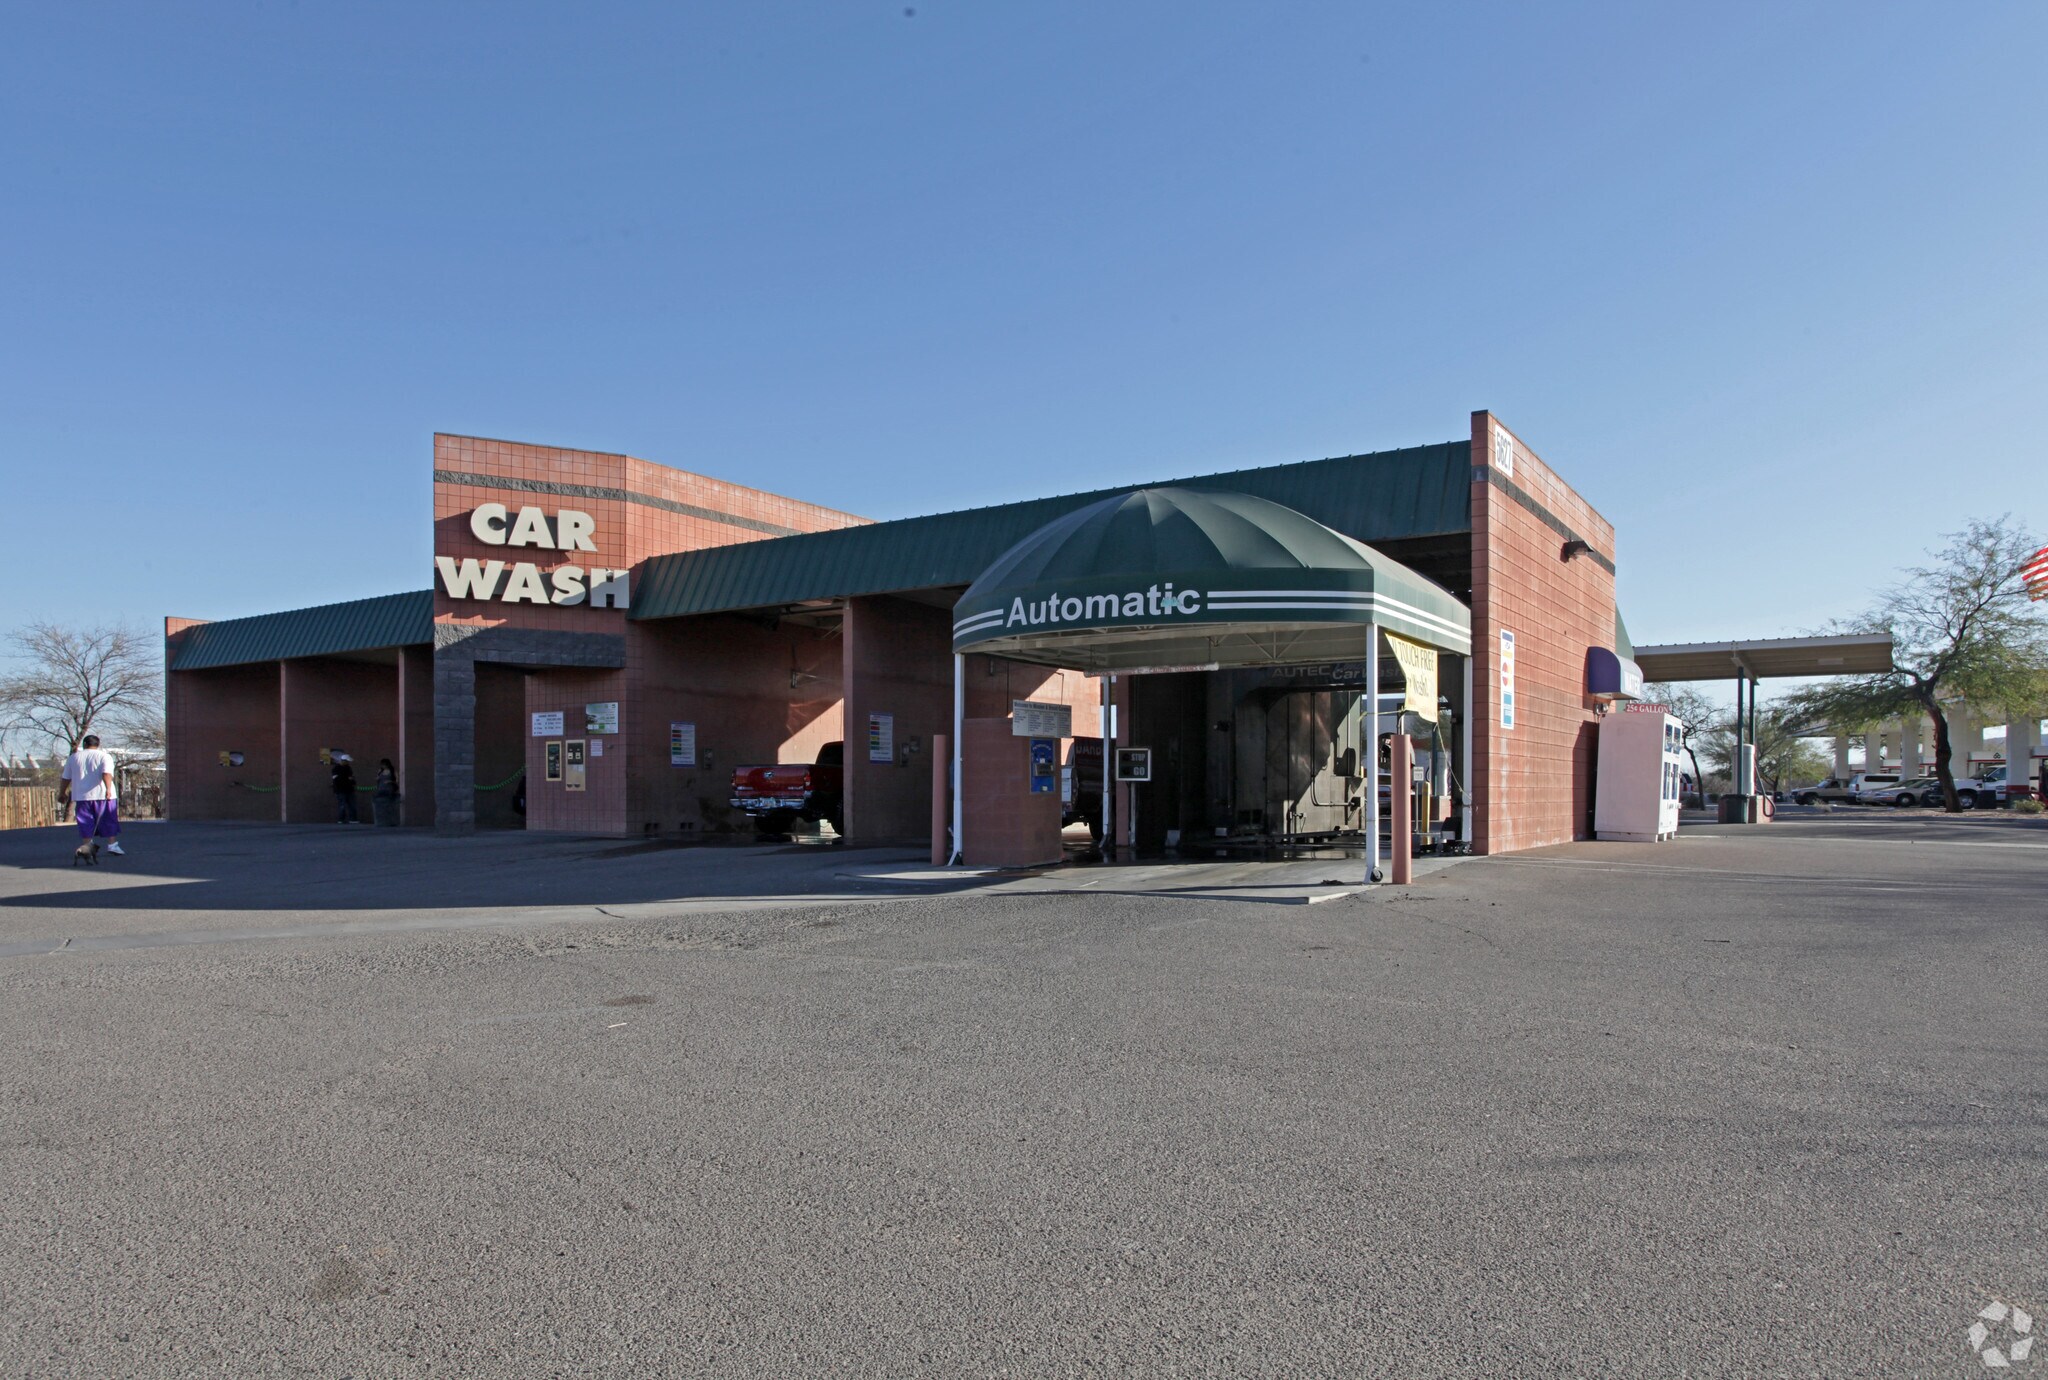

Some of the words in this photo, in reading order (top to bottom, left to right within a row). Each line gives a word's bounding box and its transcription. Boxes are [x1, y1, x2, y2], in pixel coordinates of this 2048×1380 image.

[470, 502, 598, 552] CAR
[434, 555, 630, 609] WASH
[1006, 582, 1201, 628] Automatic
[1398, 642, 1420, 669] TOUCH
[1420, 649, 1434, 671] FREE
[1271, 665, 1331, 678] AUTEC
[1332, 668, 1361, 680] Car
[1626, 704, 1638, 713] 25¢
[1639, 705, 1669, 714] GALLON
[1131, 753, 1146, 761] STOP
[1133, 766, 1145, 776] GO
